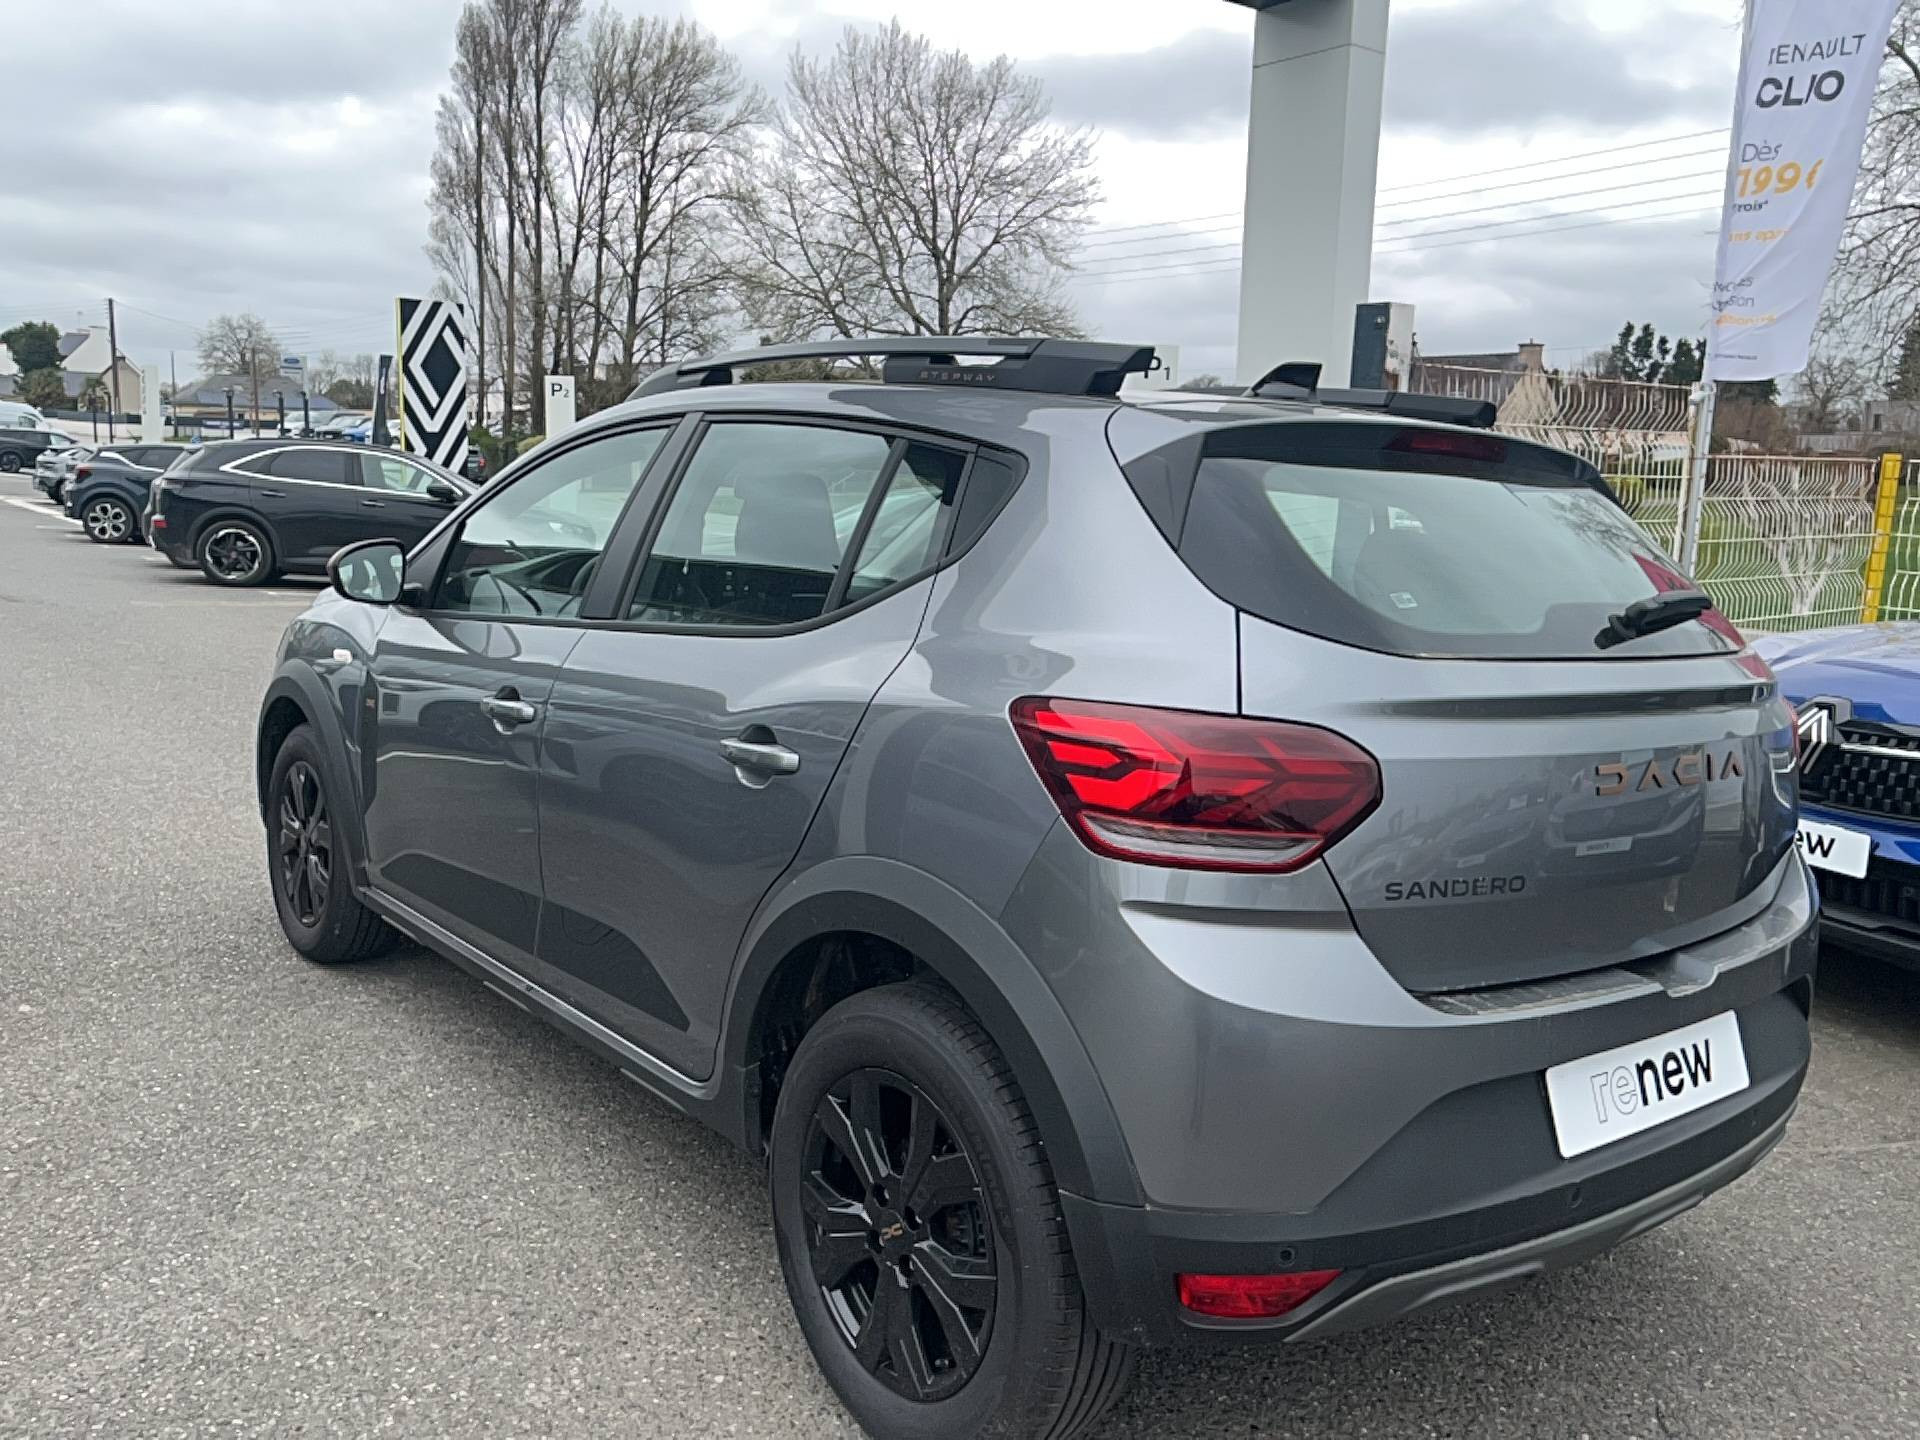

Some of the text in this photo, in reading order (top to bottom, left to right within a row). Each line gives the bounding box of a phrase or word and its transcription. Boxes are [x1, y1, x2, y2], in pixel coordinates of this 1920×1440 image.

[1755, 69, 1846, 108] CLIO
[1741, 140, 1783, 163] Dès
[551, 383, 569, 398] P2
[1595, 751, 1745, 796] DACIA
[1384, 875, 1526, 901] SANDERO
[1590, 1038, 1713, 1124] renew
